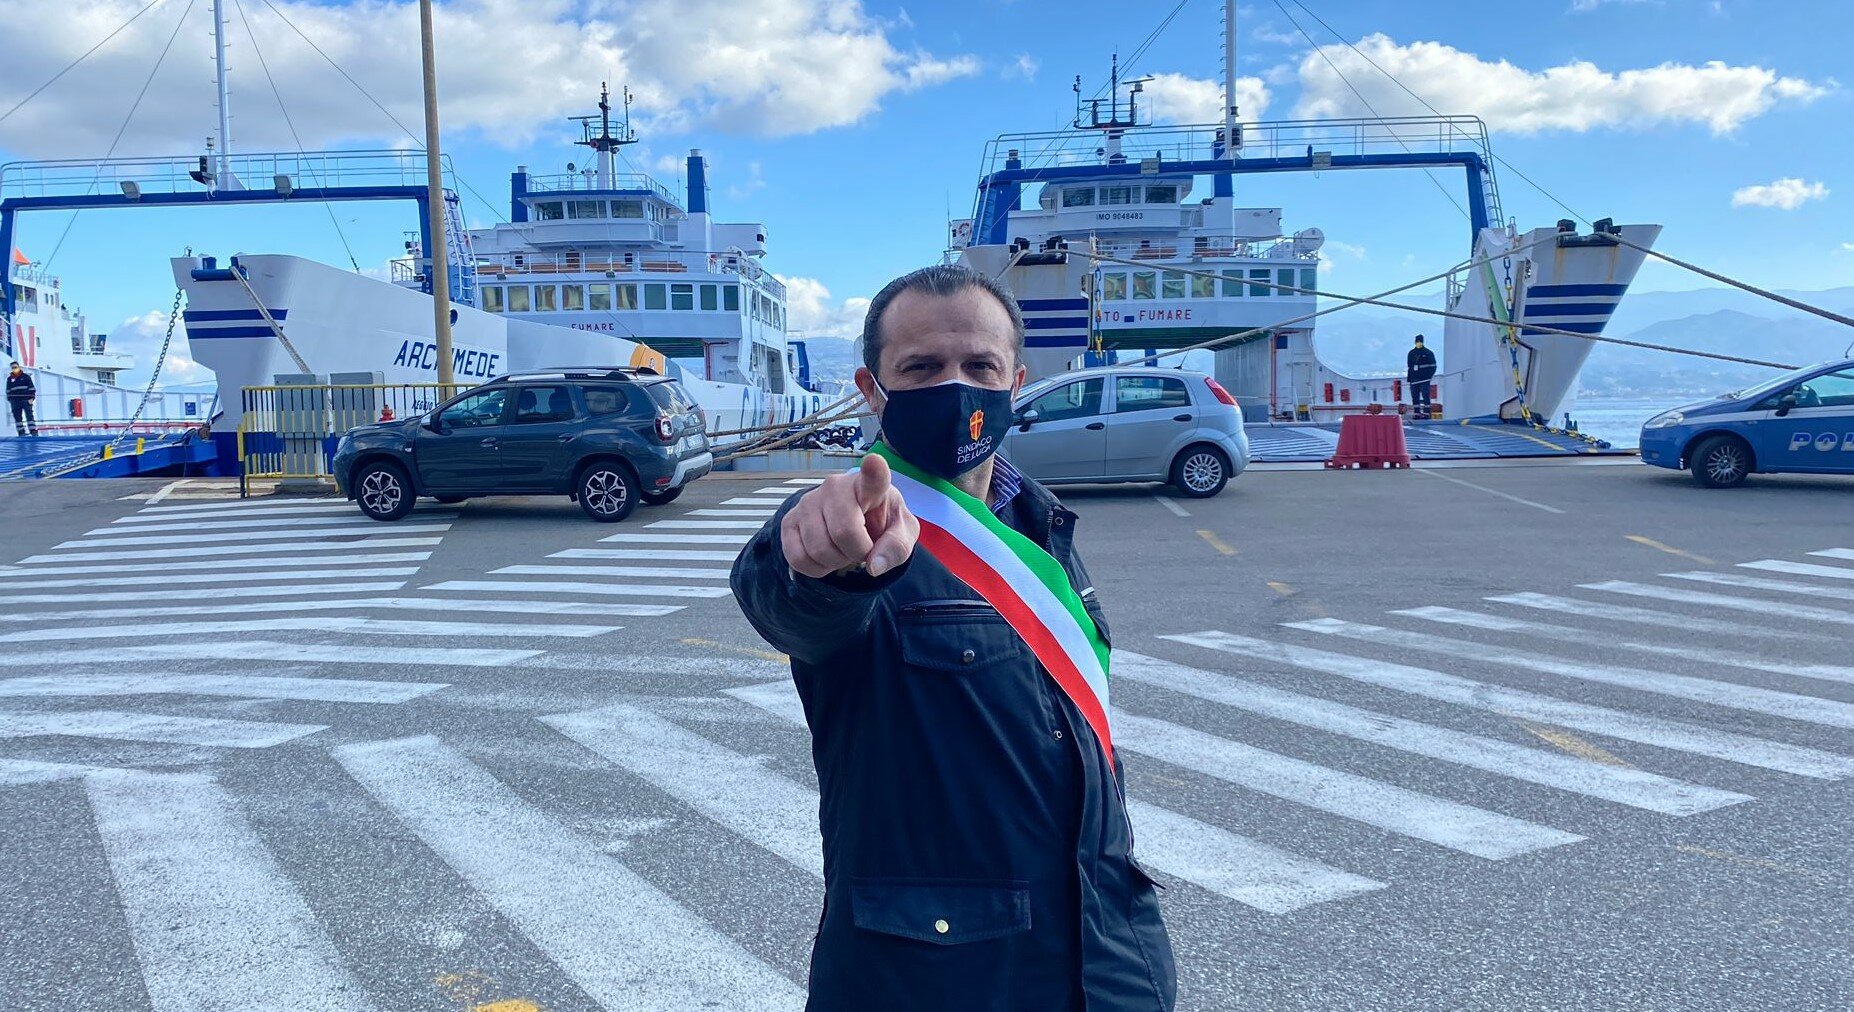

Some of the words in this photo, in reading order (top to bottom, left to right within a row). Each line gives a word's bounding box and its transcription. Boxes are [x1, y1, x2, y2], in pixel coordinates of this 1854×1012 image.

[1112, 212, 1143, 220] 9048483
[1139, 309, 1192, 321] FUMARE
[571, 323, 615, 331] FUMARE
[393, 340, 499, 378] ARCMEDE
[957, 435, 992, 455] SINDACO
[957, 453, 971, 464] DE
[970, 444, 991, 461] LUCA
